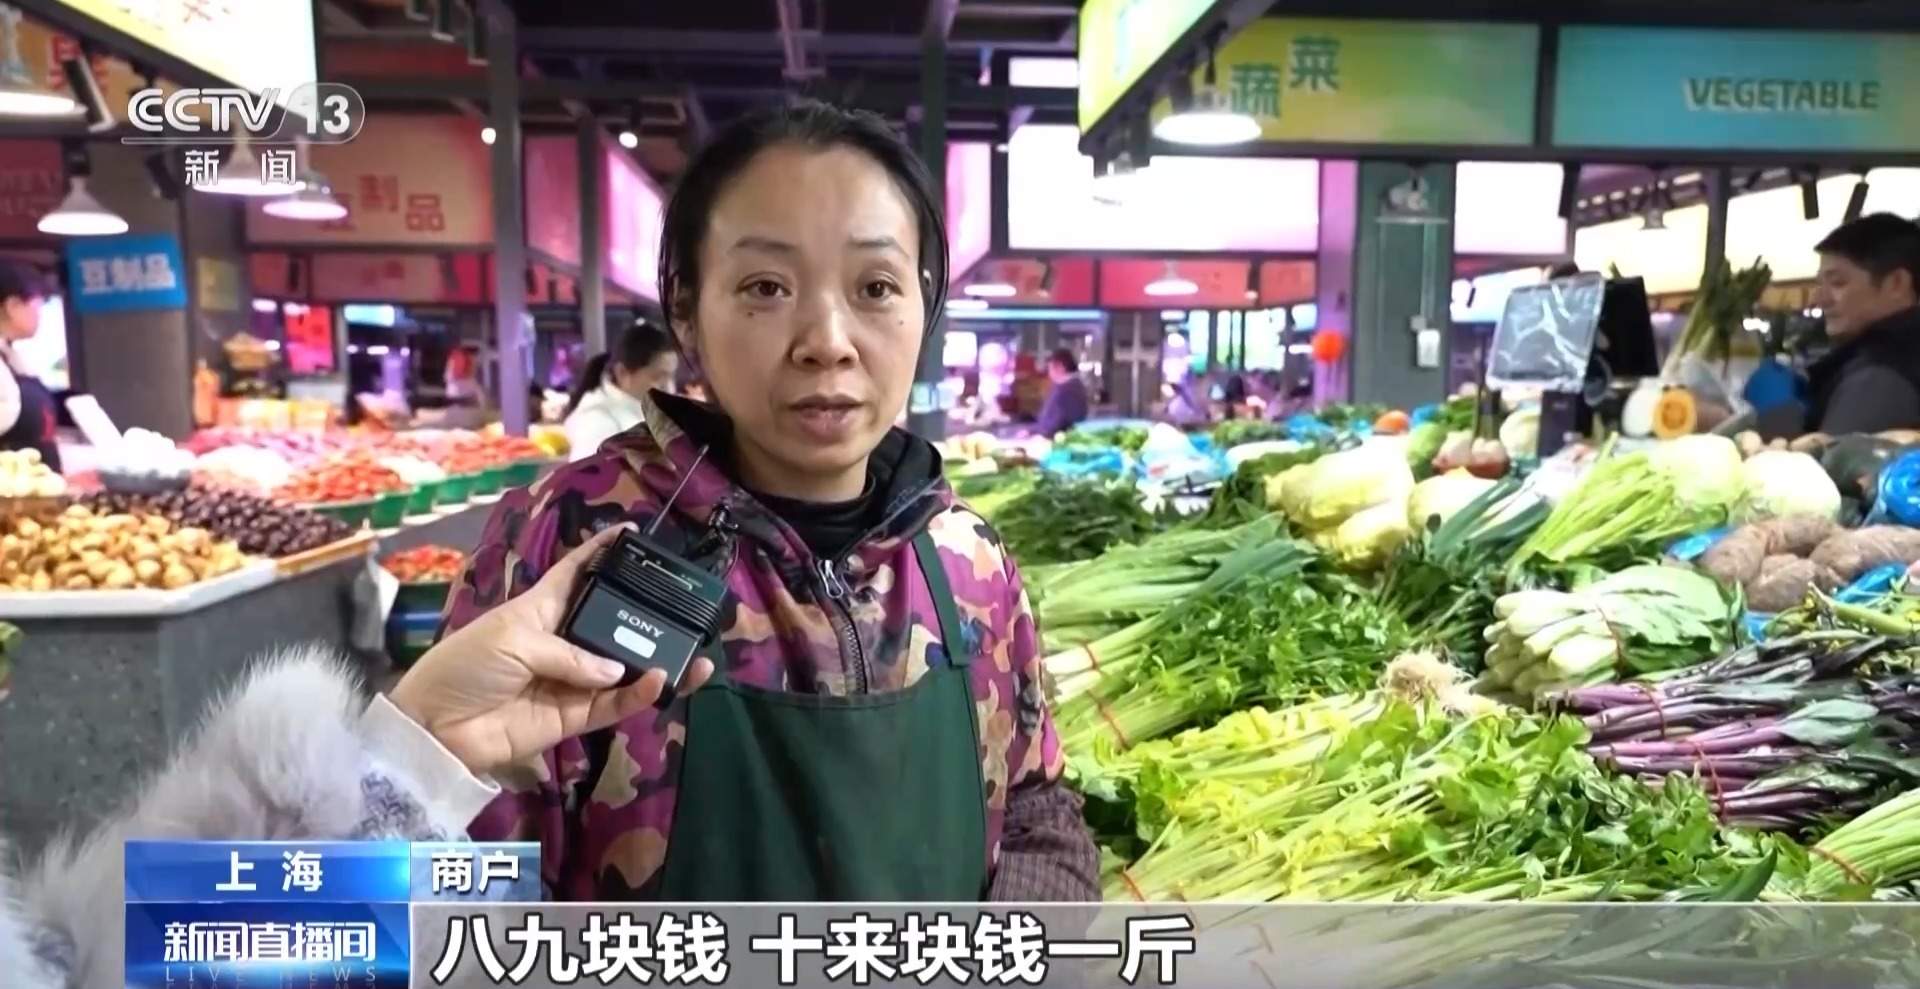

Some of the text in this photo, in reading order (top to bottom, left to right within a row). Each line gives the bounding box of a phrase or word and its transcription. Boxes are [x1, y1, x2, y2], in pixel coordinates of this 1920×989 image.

[1231, 35, 1341, 118] 蔬菜
[1682, 77, 1881, 113] VEGETABLE
[616, 609, 664, 638] SONY
